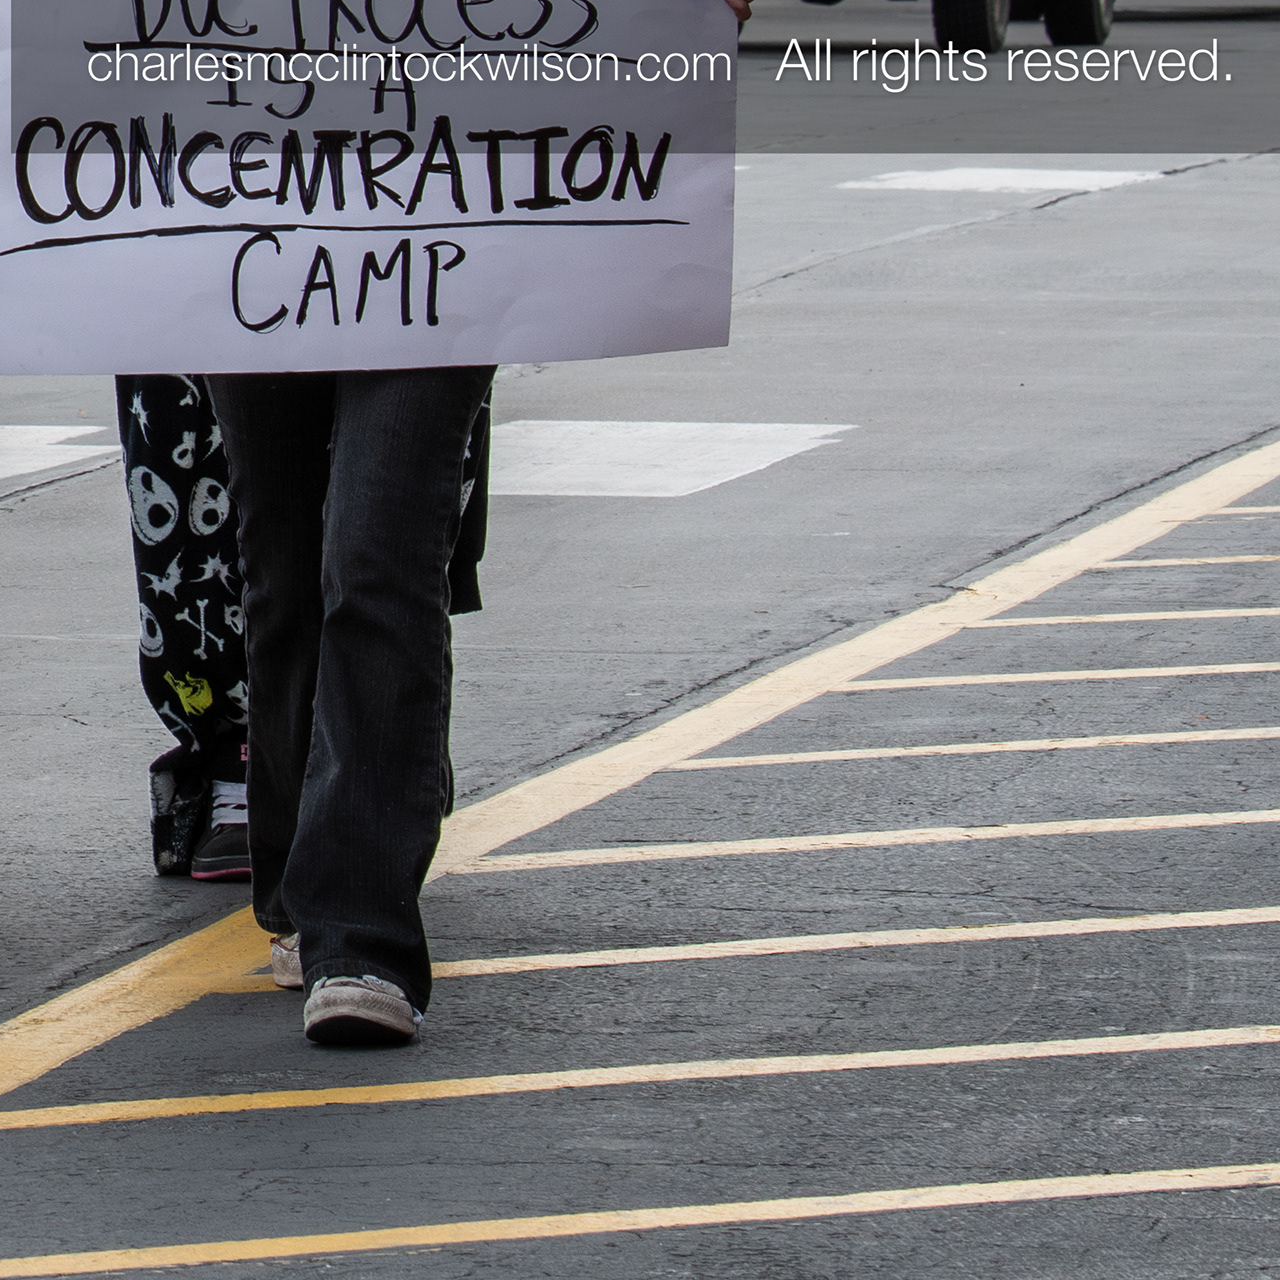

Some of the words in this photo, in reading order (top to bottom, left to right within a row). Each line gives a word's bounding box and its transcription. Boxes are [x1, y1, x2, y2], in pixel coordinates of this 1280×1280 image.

[206, 52, 315, 119] IS
[15, 113, 670, 224] CONCENTRATION
[232, 231, 466, 332] CAMP
